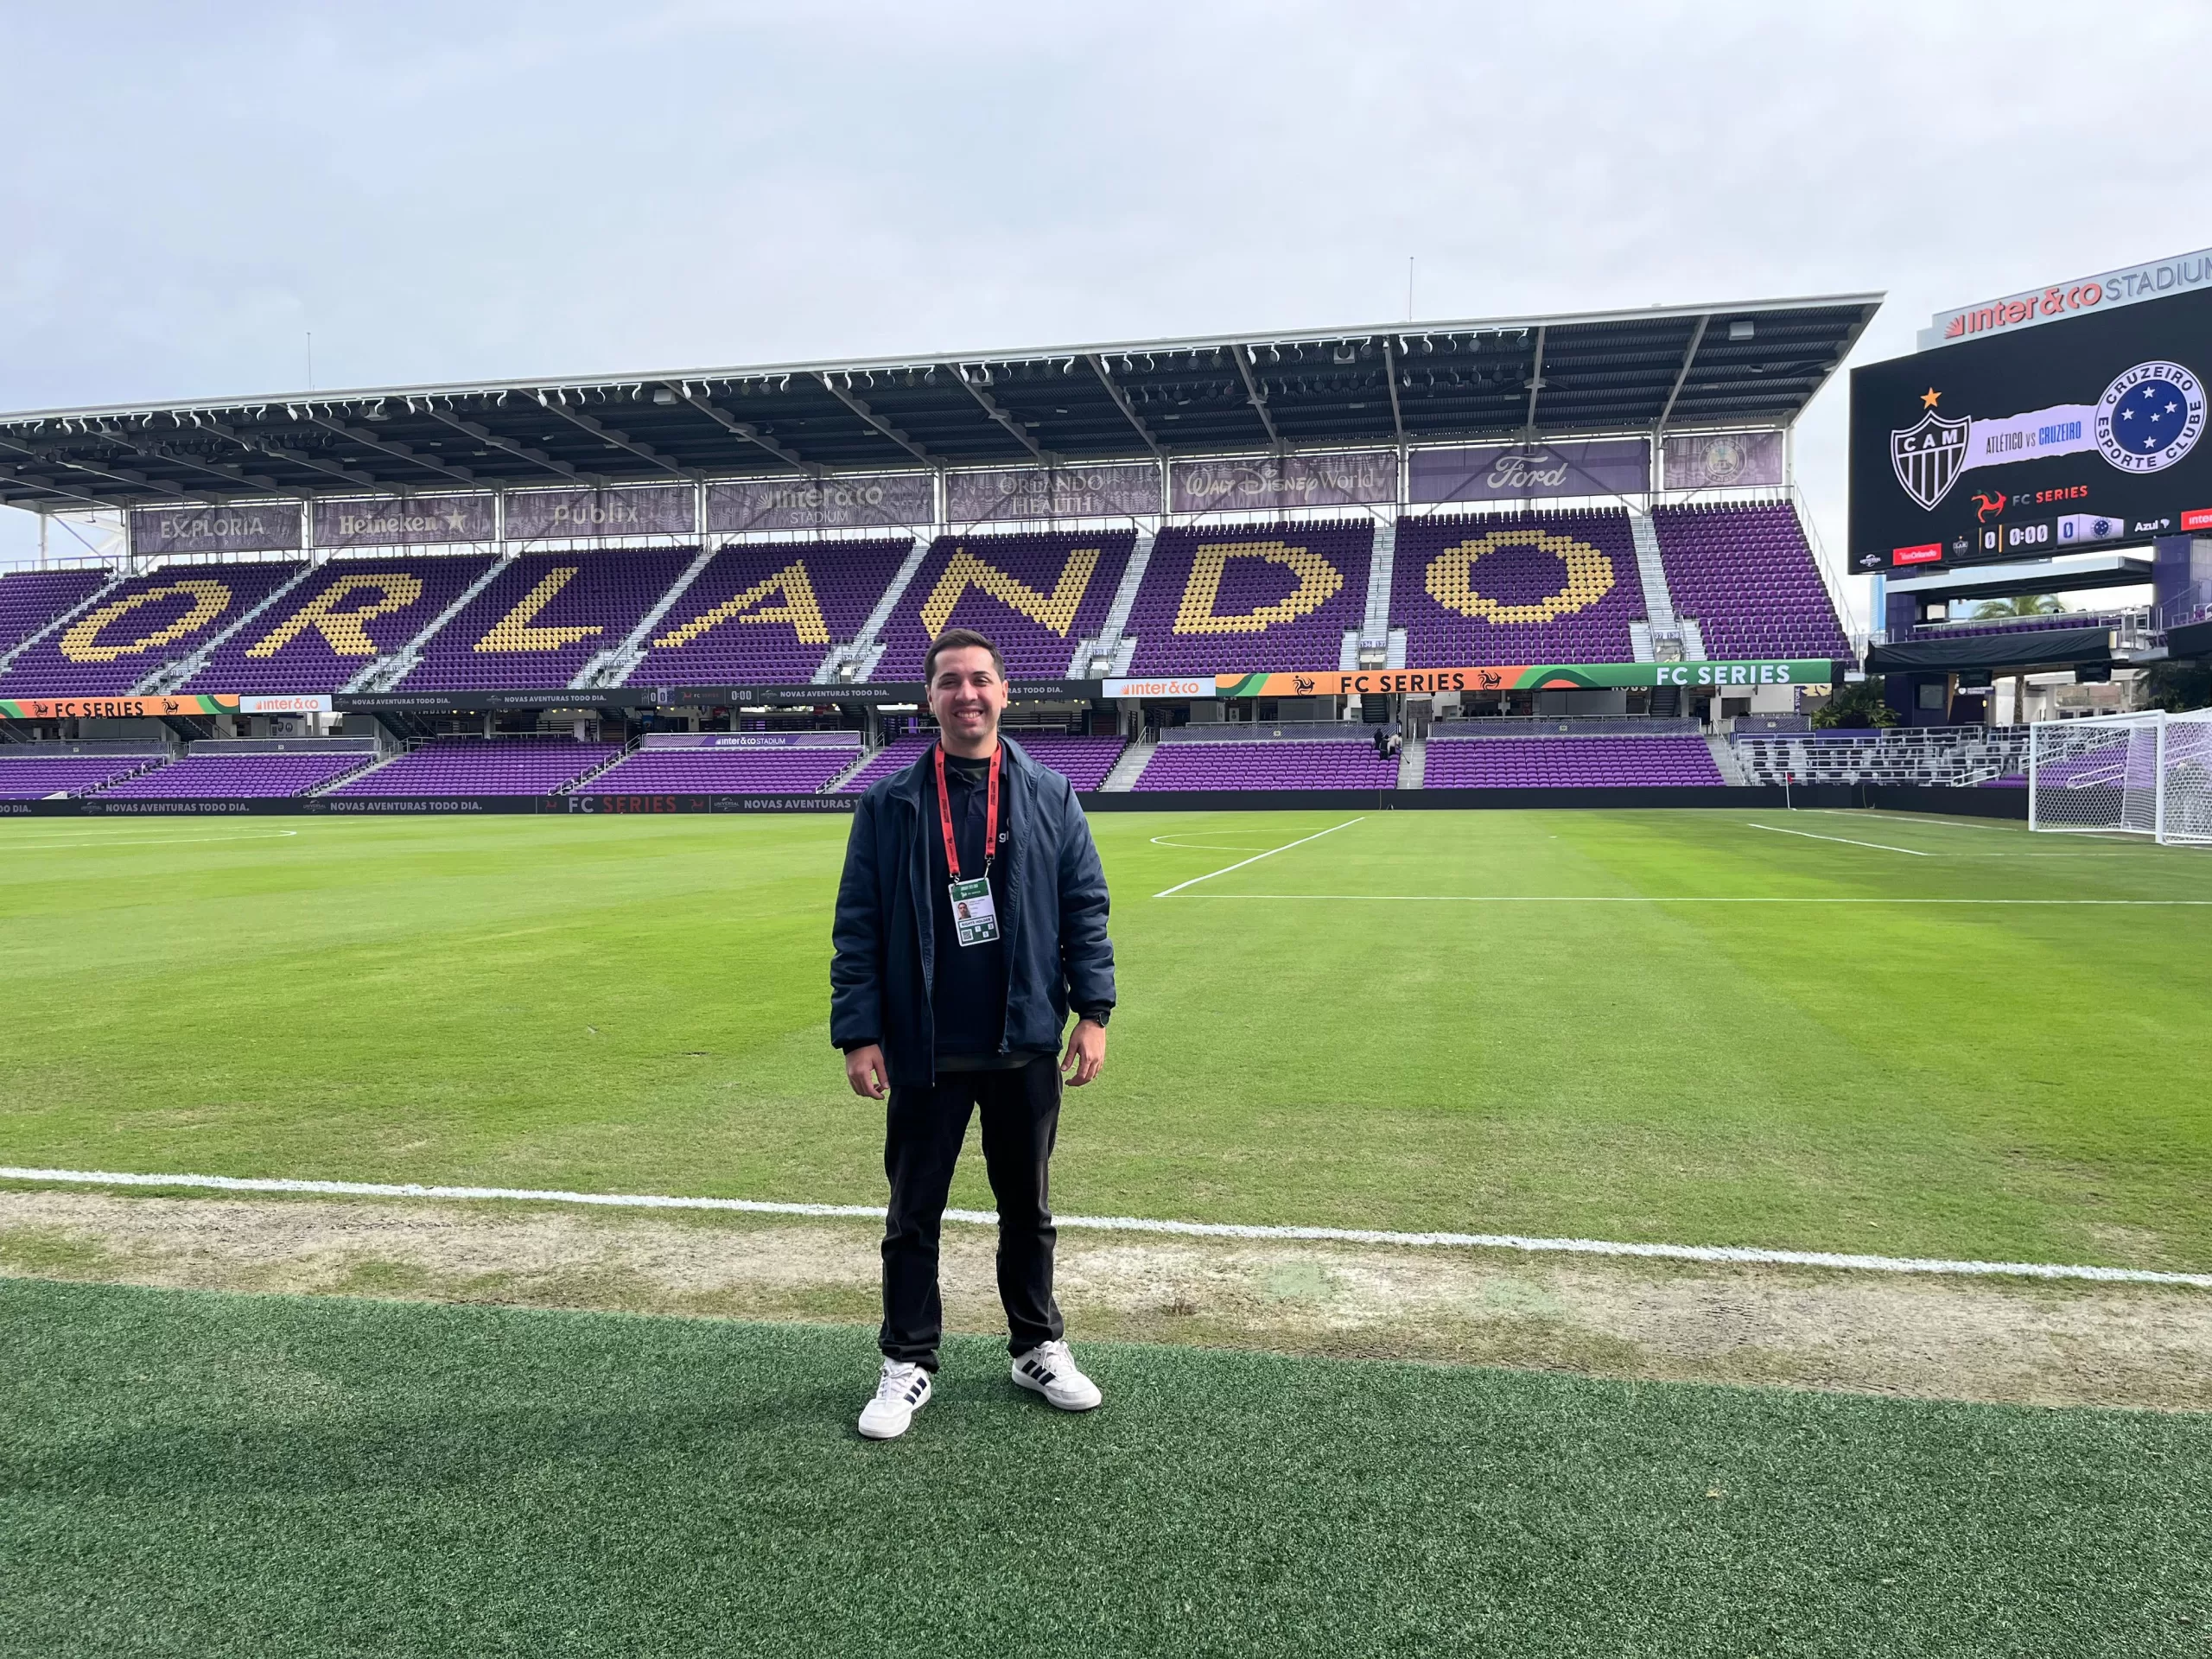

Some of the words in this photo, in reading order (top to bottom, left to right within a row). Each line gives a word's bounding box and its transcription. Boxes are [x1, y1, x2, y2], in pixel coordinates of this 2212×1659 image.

[2105, 366, 2193, 404] CRUZEIRO
[1904, 429, 1958, 452] CAM
[1986, 429, 2023, 454] ATLÉTICO
[2026, 432, 2036, 448] VS
[2038, 421, 2082, 445] CRUZEIRO
[2098, 416, 2157, 467] ESPORTE
[2165, 400, 2201, 459] CLUBE
[1319, 468, 1374, 489] World
[1486, 455, 1570, 488] Ford
[1000, 475, 1103, 494] ORLANDO
[1011, 496, 1091, 514] HEALTH
[2012, 494, 2031, 506] FC
[2036, 485, 2088, 503] SERIES
[555, 503, 639, 524] Publix
[790, 511, 849, 524] STADIUM
[161, 514, 264, 538] EXPLORIA
[339, 514, 437, 535] Heineken
[2063, 522, 2073, 538] 0
[2134, 520, 2158, 532] Azul
[1985, 531, 1995, 550] 0
[2009, 524, 2048, 546] 0:00
[59, 529, 1616, 663] ORLANDO
[1340, 675, 1370, 693] FC
[1380, 673, 1464, 692] SERIES
[1656, 666, 1688, 685] FC
[1698, 664, 1790, 684] SERIES
[650, 692, 657, 702] 0
[660, 692, 666, 702] 0
[731, 690, 752, 700] 0:00
[54, 702, 75, 717] FC
[83, 702, 143, 717] SERIES
[12, 804, 32, 813] DIA.
[105, 804, 138, 812] NOVAS
[140, 804, 197, 812] AVENTURAS
[229, 803, 250, 811] DIA.
[330, 802, 365, 810] NOVAS
[367, 802, 427, 810] AVENTURAS
[429, 802, 458, 810] TODO
[461, 801, 482, 810] DIA.
[569, 797, 594, 813] FC
[603, 796, 677, 812] SERIES
[744, 799, 782, 809] NOVAS
[785, 799, 851, 809] AVENTURAS
